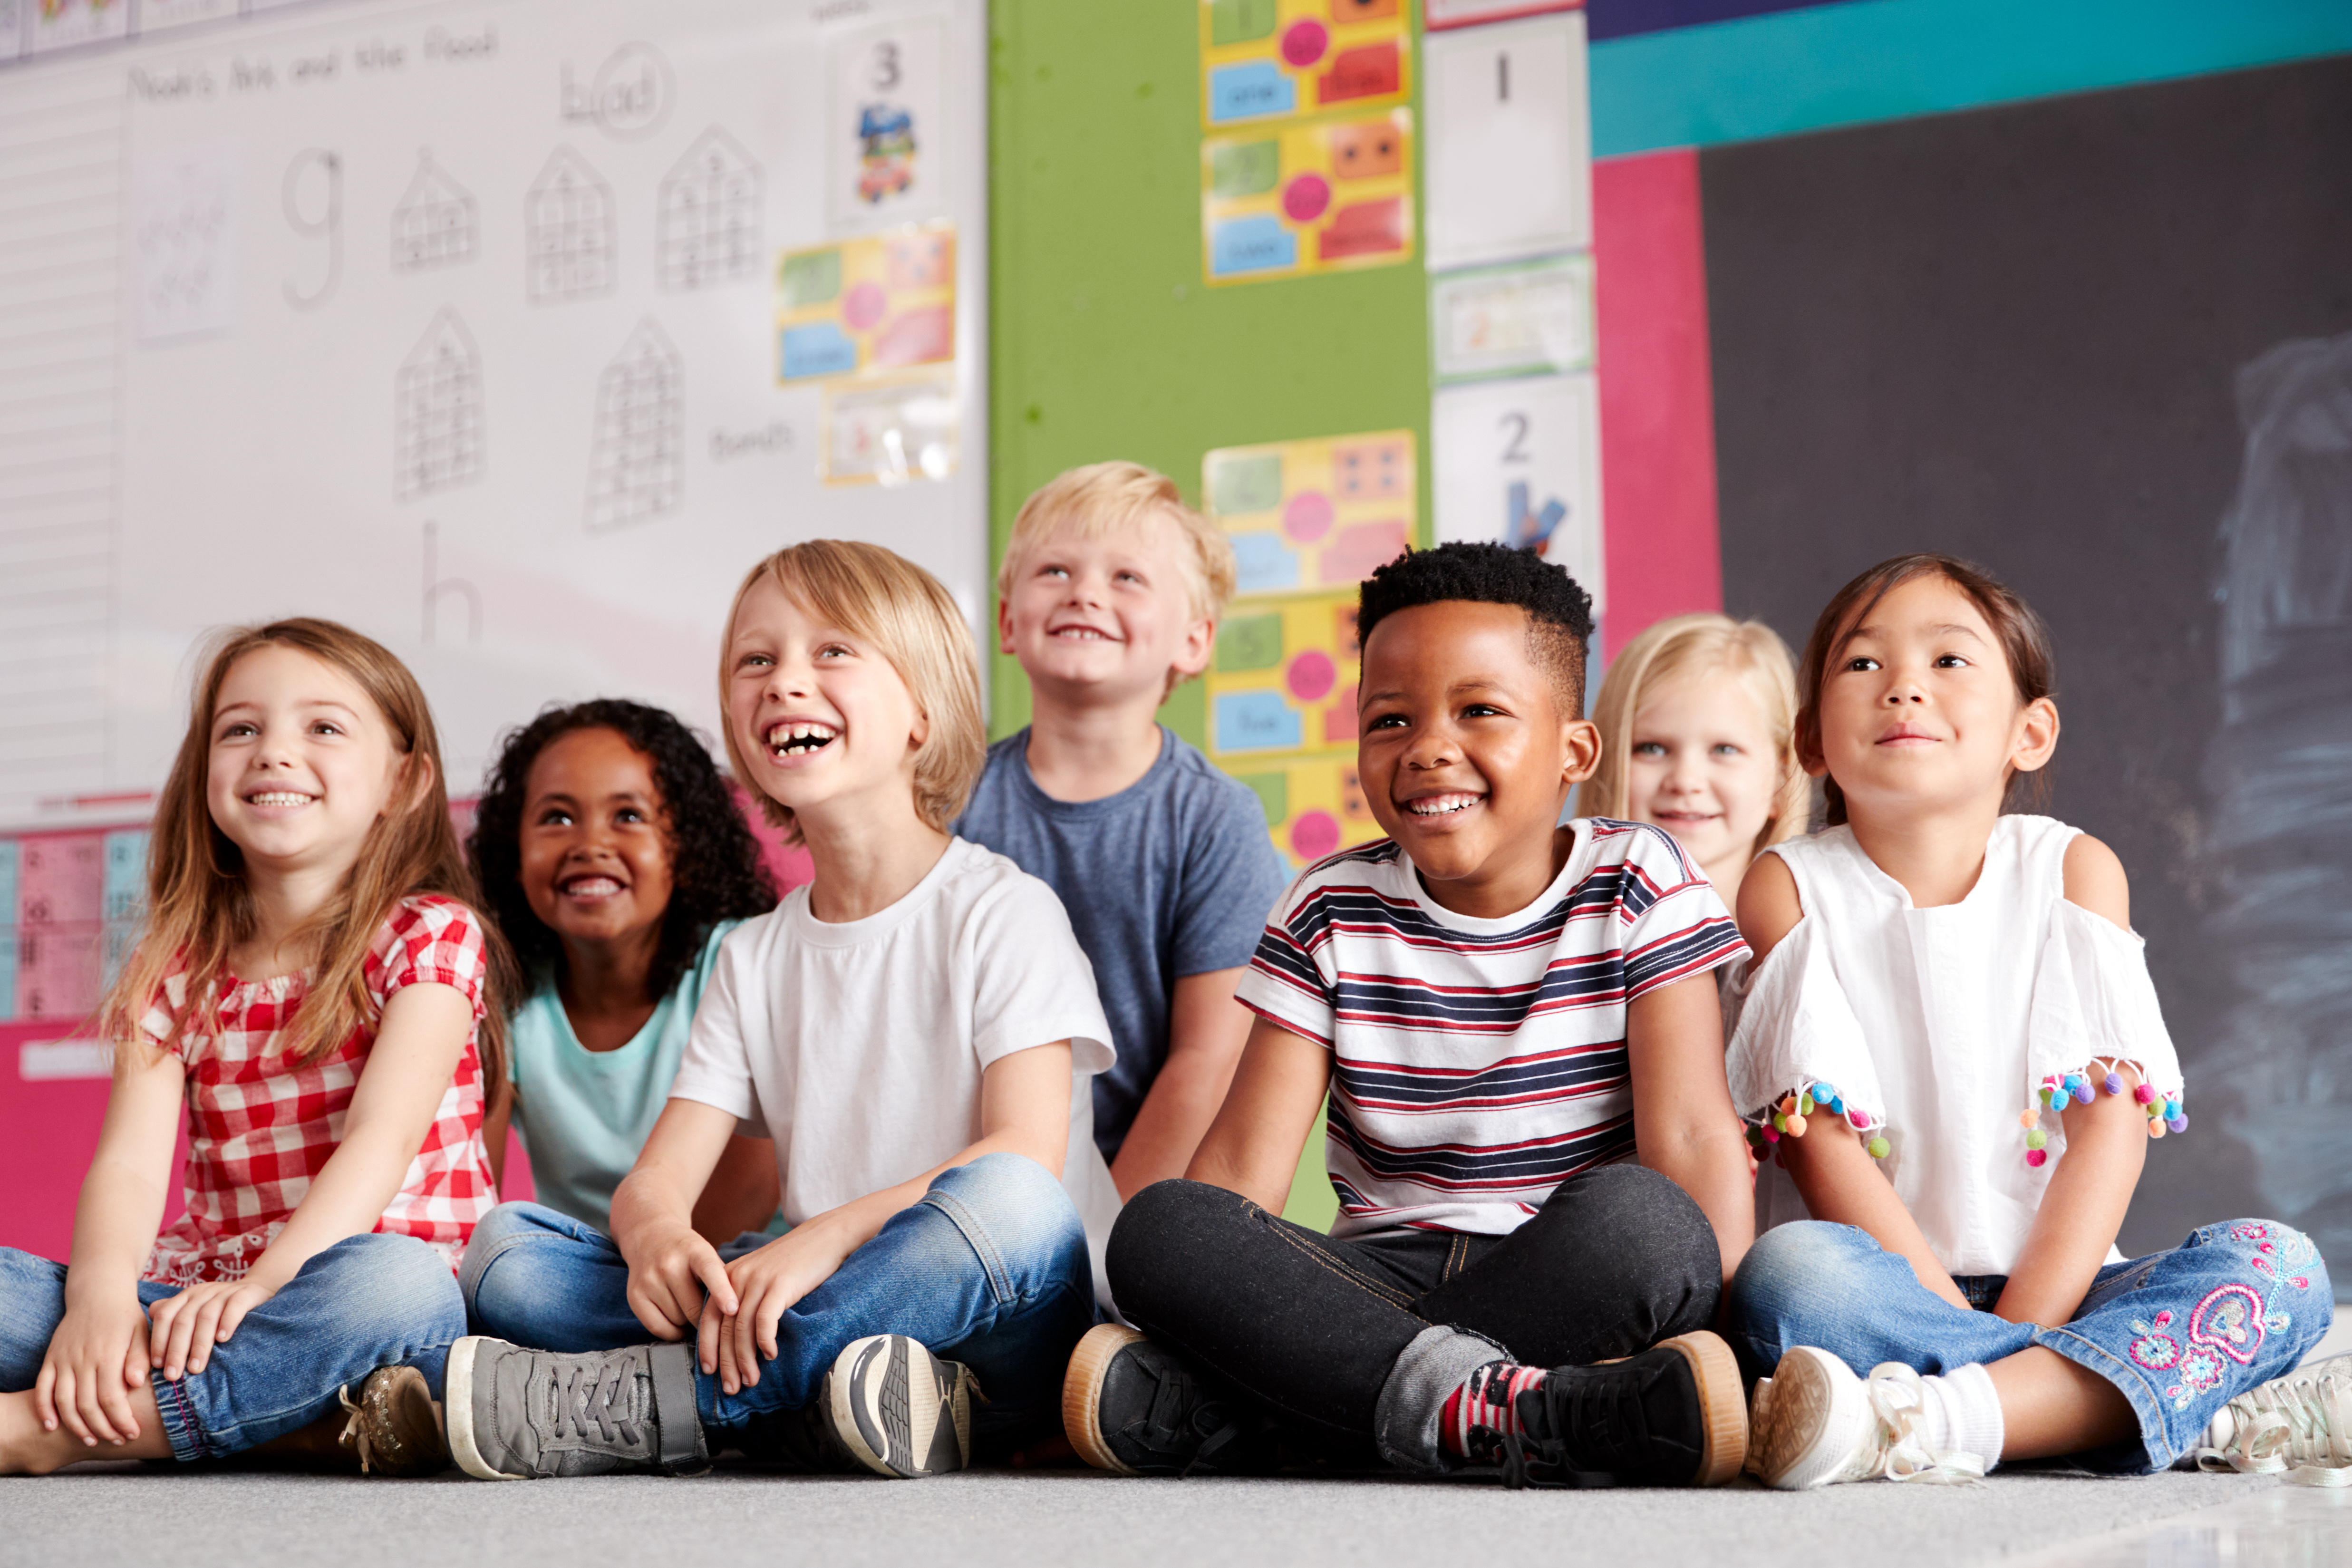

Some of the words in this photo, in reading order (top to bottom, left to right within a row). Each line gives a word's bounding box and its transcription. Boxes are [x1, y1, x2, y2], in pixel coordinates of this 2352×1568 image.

[869, 39, 905, 94] 3
[282, 147, 344, 314] g
[1496, 407, 1534, 465] 2
[421, 518, 483, 648] h
